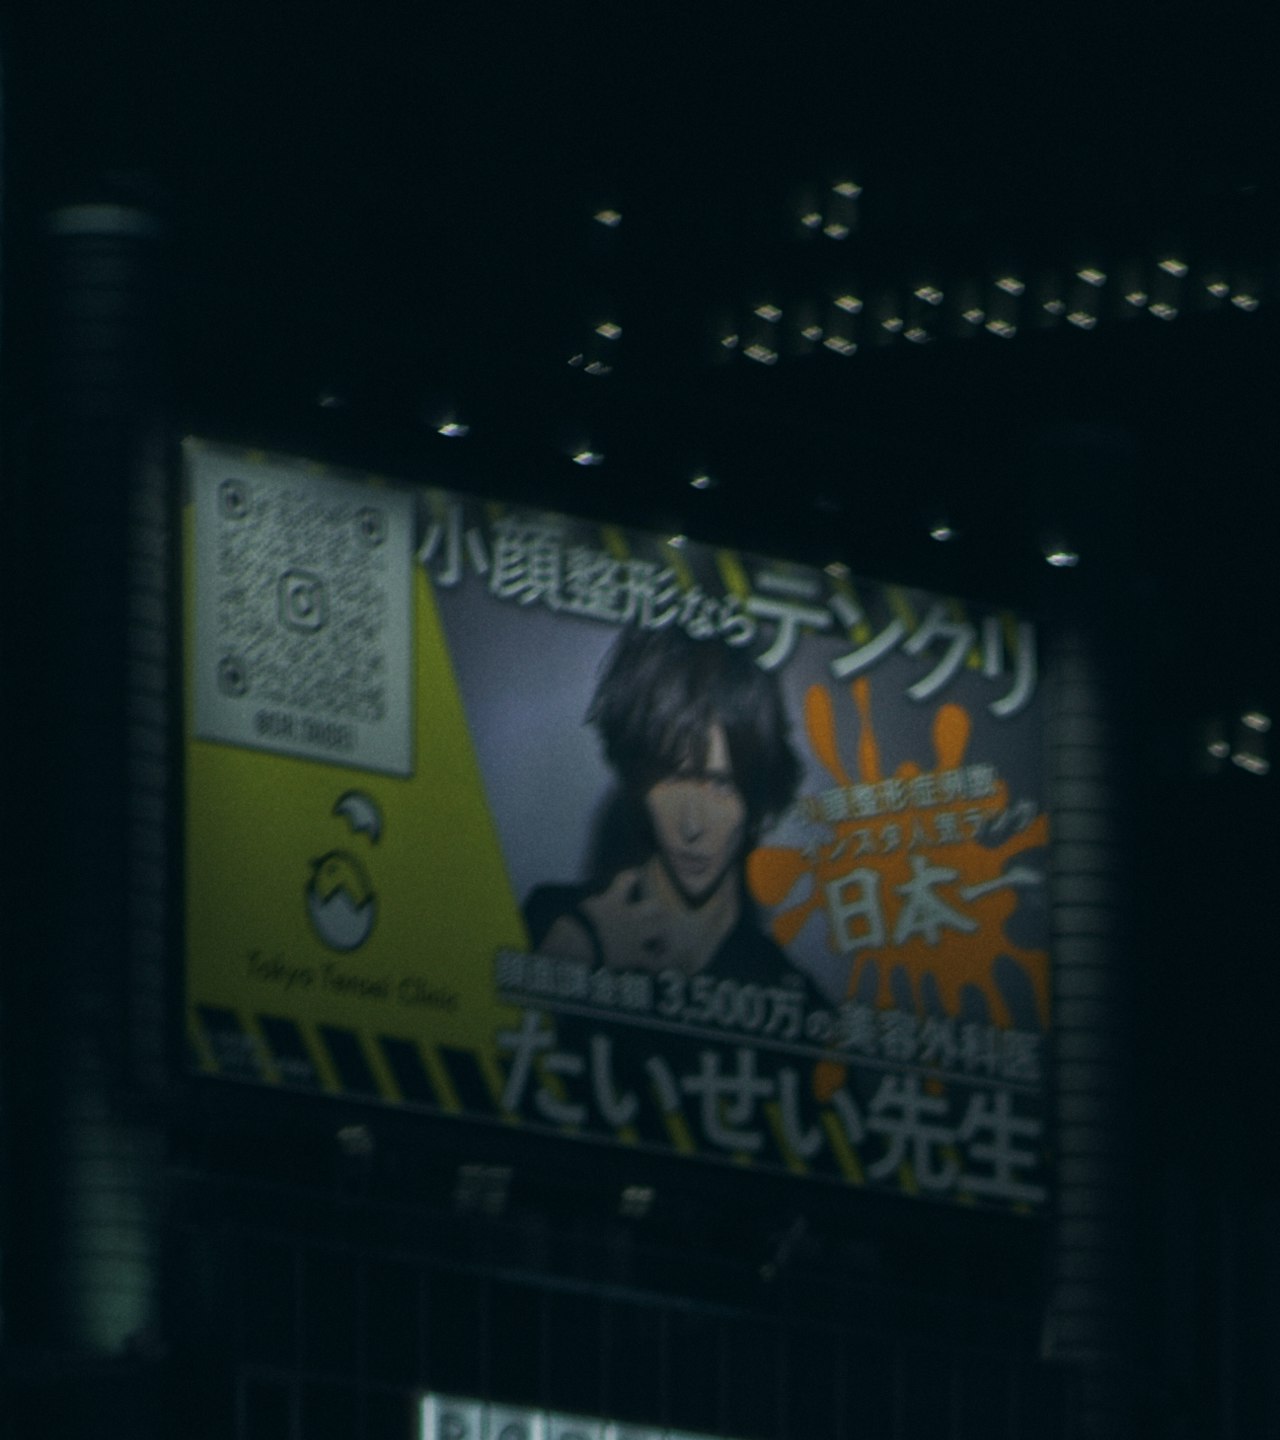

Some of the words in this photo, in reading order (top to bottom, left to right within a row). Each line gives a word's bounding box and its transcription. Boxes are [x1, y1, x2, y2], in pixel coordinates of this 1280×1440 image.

[826, 853, 1043, 953] 日本一
[496, 1008, 1047, 1202] たいせい先生
